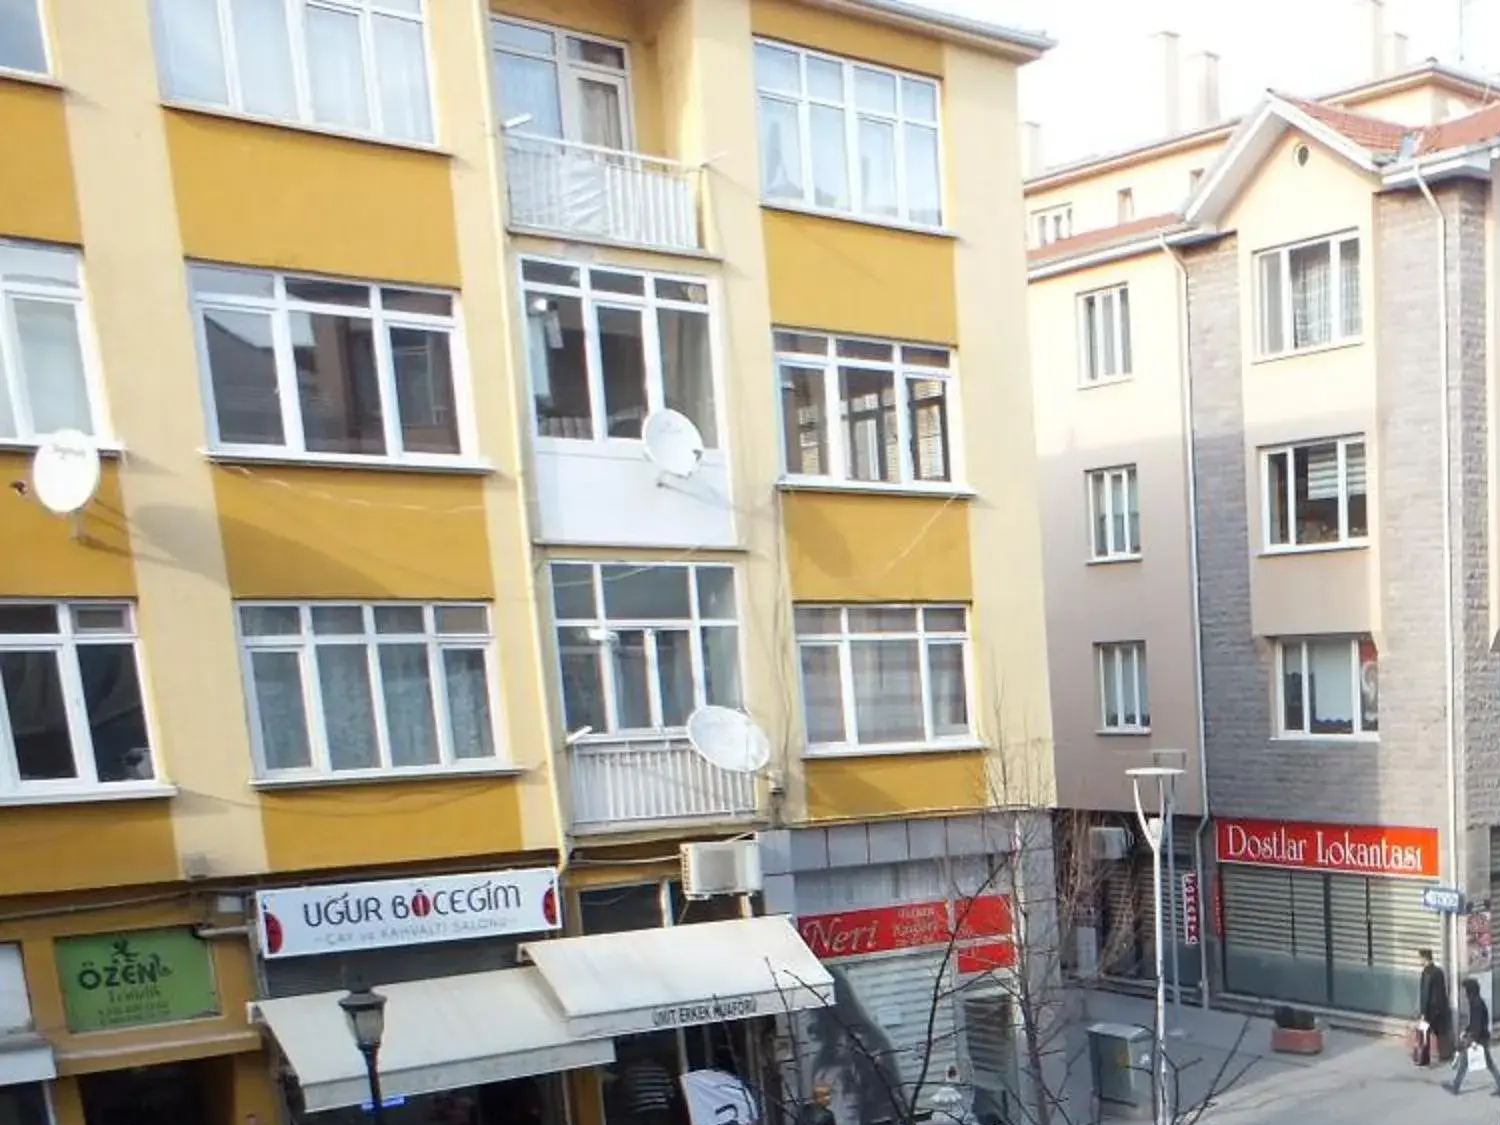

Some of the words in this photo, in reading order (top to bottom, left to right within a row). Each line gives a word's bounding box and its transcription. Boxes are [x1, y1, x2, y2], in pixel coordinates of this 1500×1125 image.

[1226, 823, 1307, 862] Dostlar
[1316, 830, 1423, 873] Lokantası
[802, 917, 879, 953] Neri
[78, 960, 158, 990] ÖZEN
